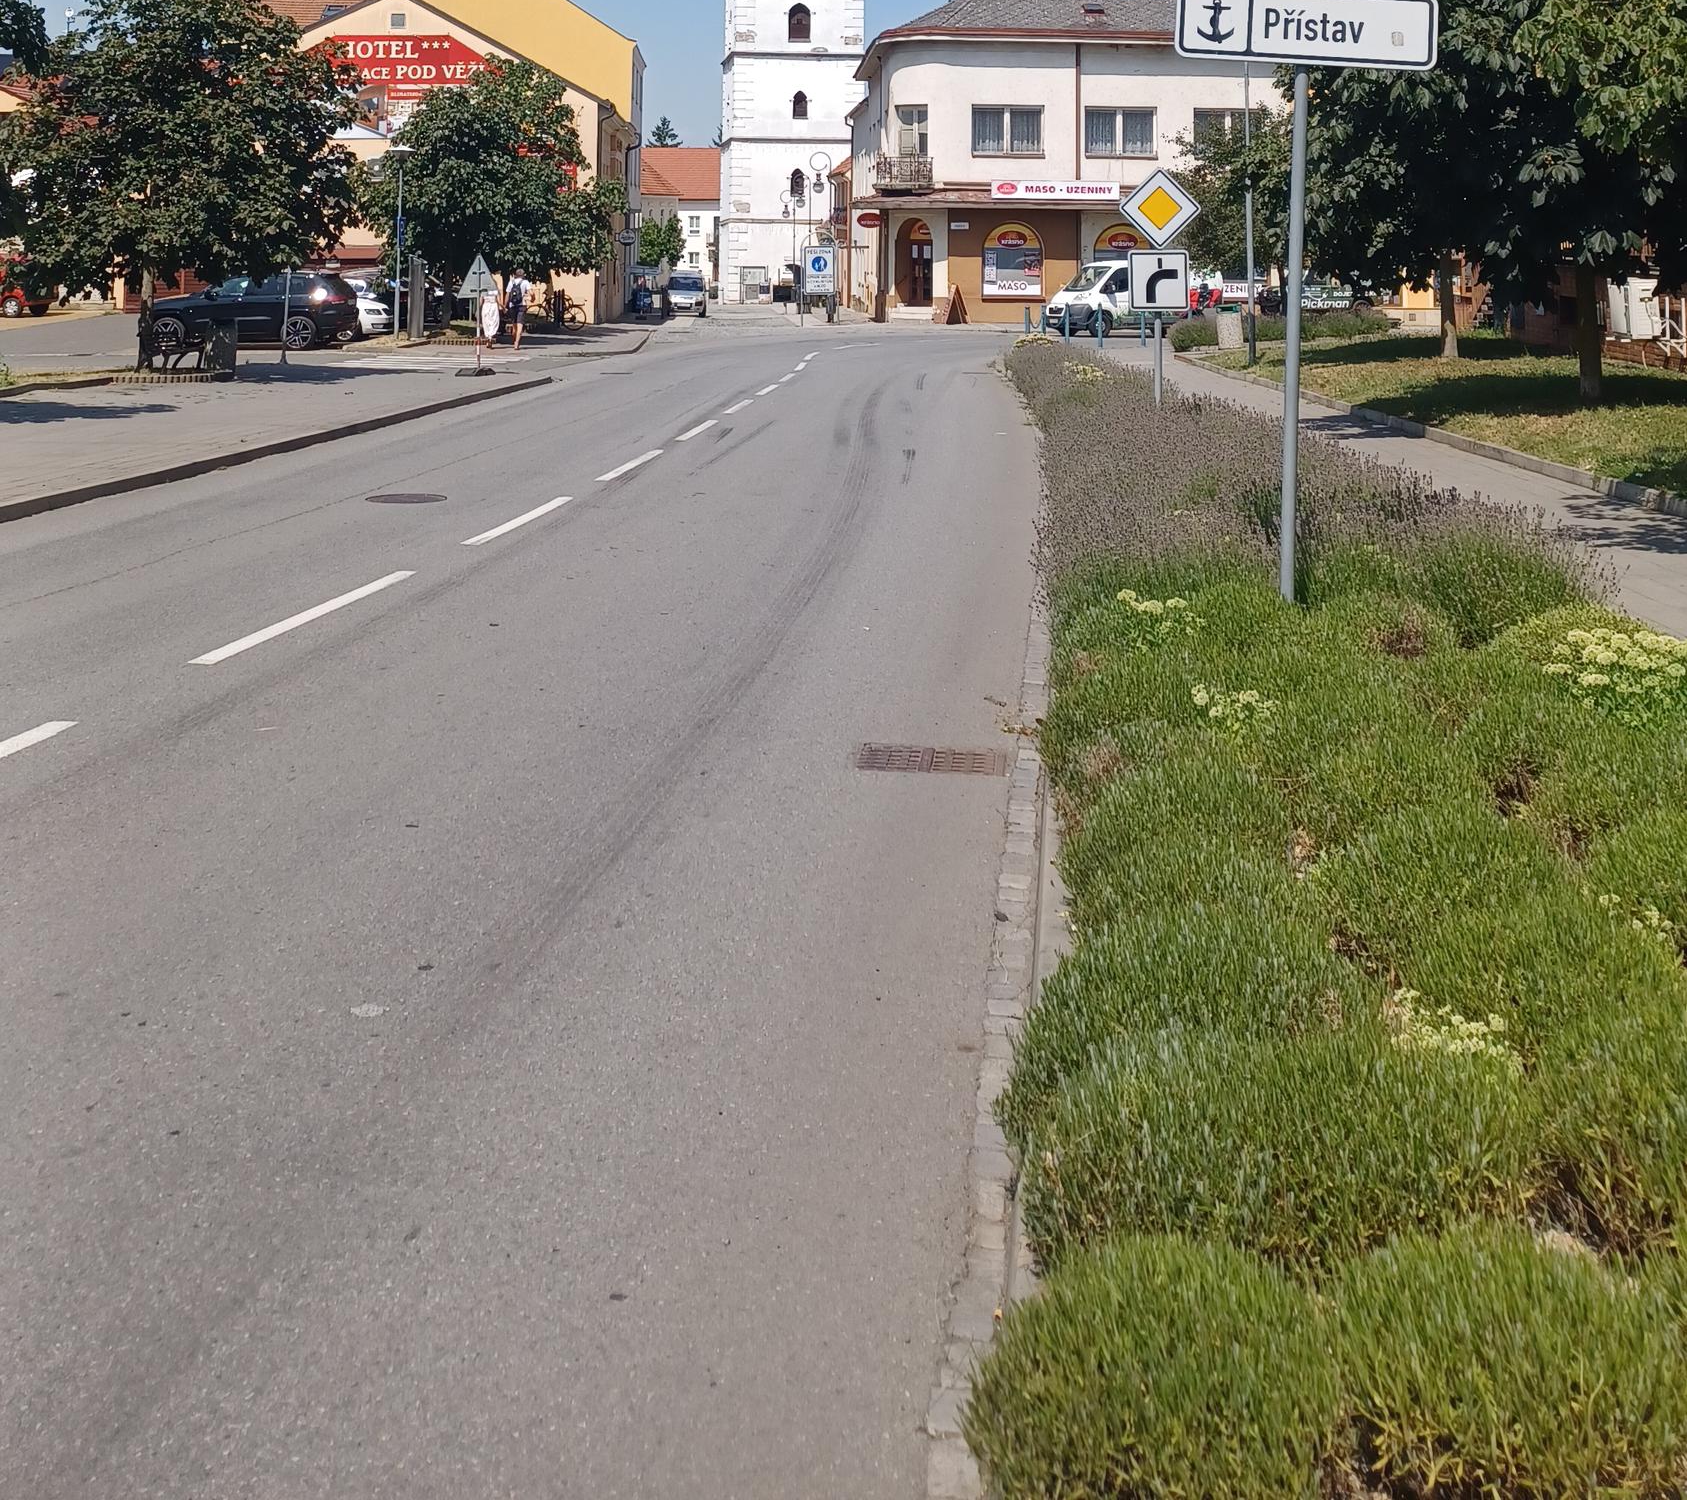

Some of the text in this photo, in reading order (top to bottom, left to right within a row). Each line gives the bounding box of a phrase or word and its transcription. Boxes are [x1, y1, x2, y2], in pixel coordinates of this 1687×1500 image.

[1263, 7, 1365, 44] Přístav
[338, 40, 419, 59] HOTEL
[395, 64, 437, 80] POD
[1024, 185, 1056, 194] MASO
[1066, 185, 1113, 194] UZENINY
[997, 282, 1028, 291] MASO
[1301, 298, 1350, 309] Pickman
